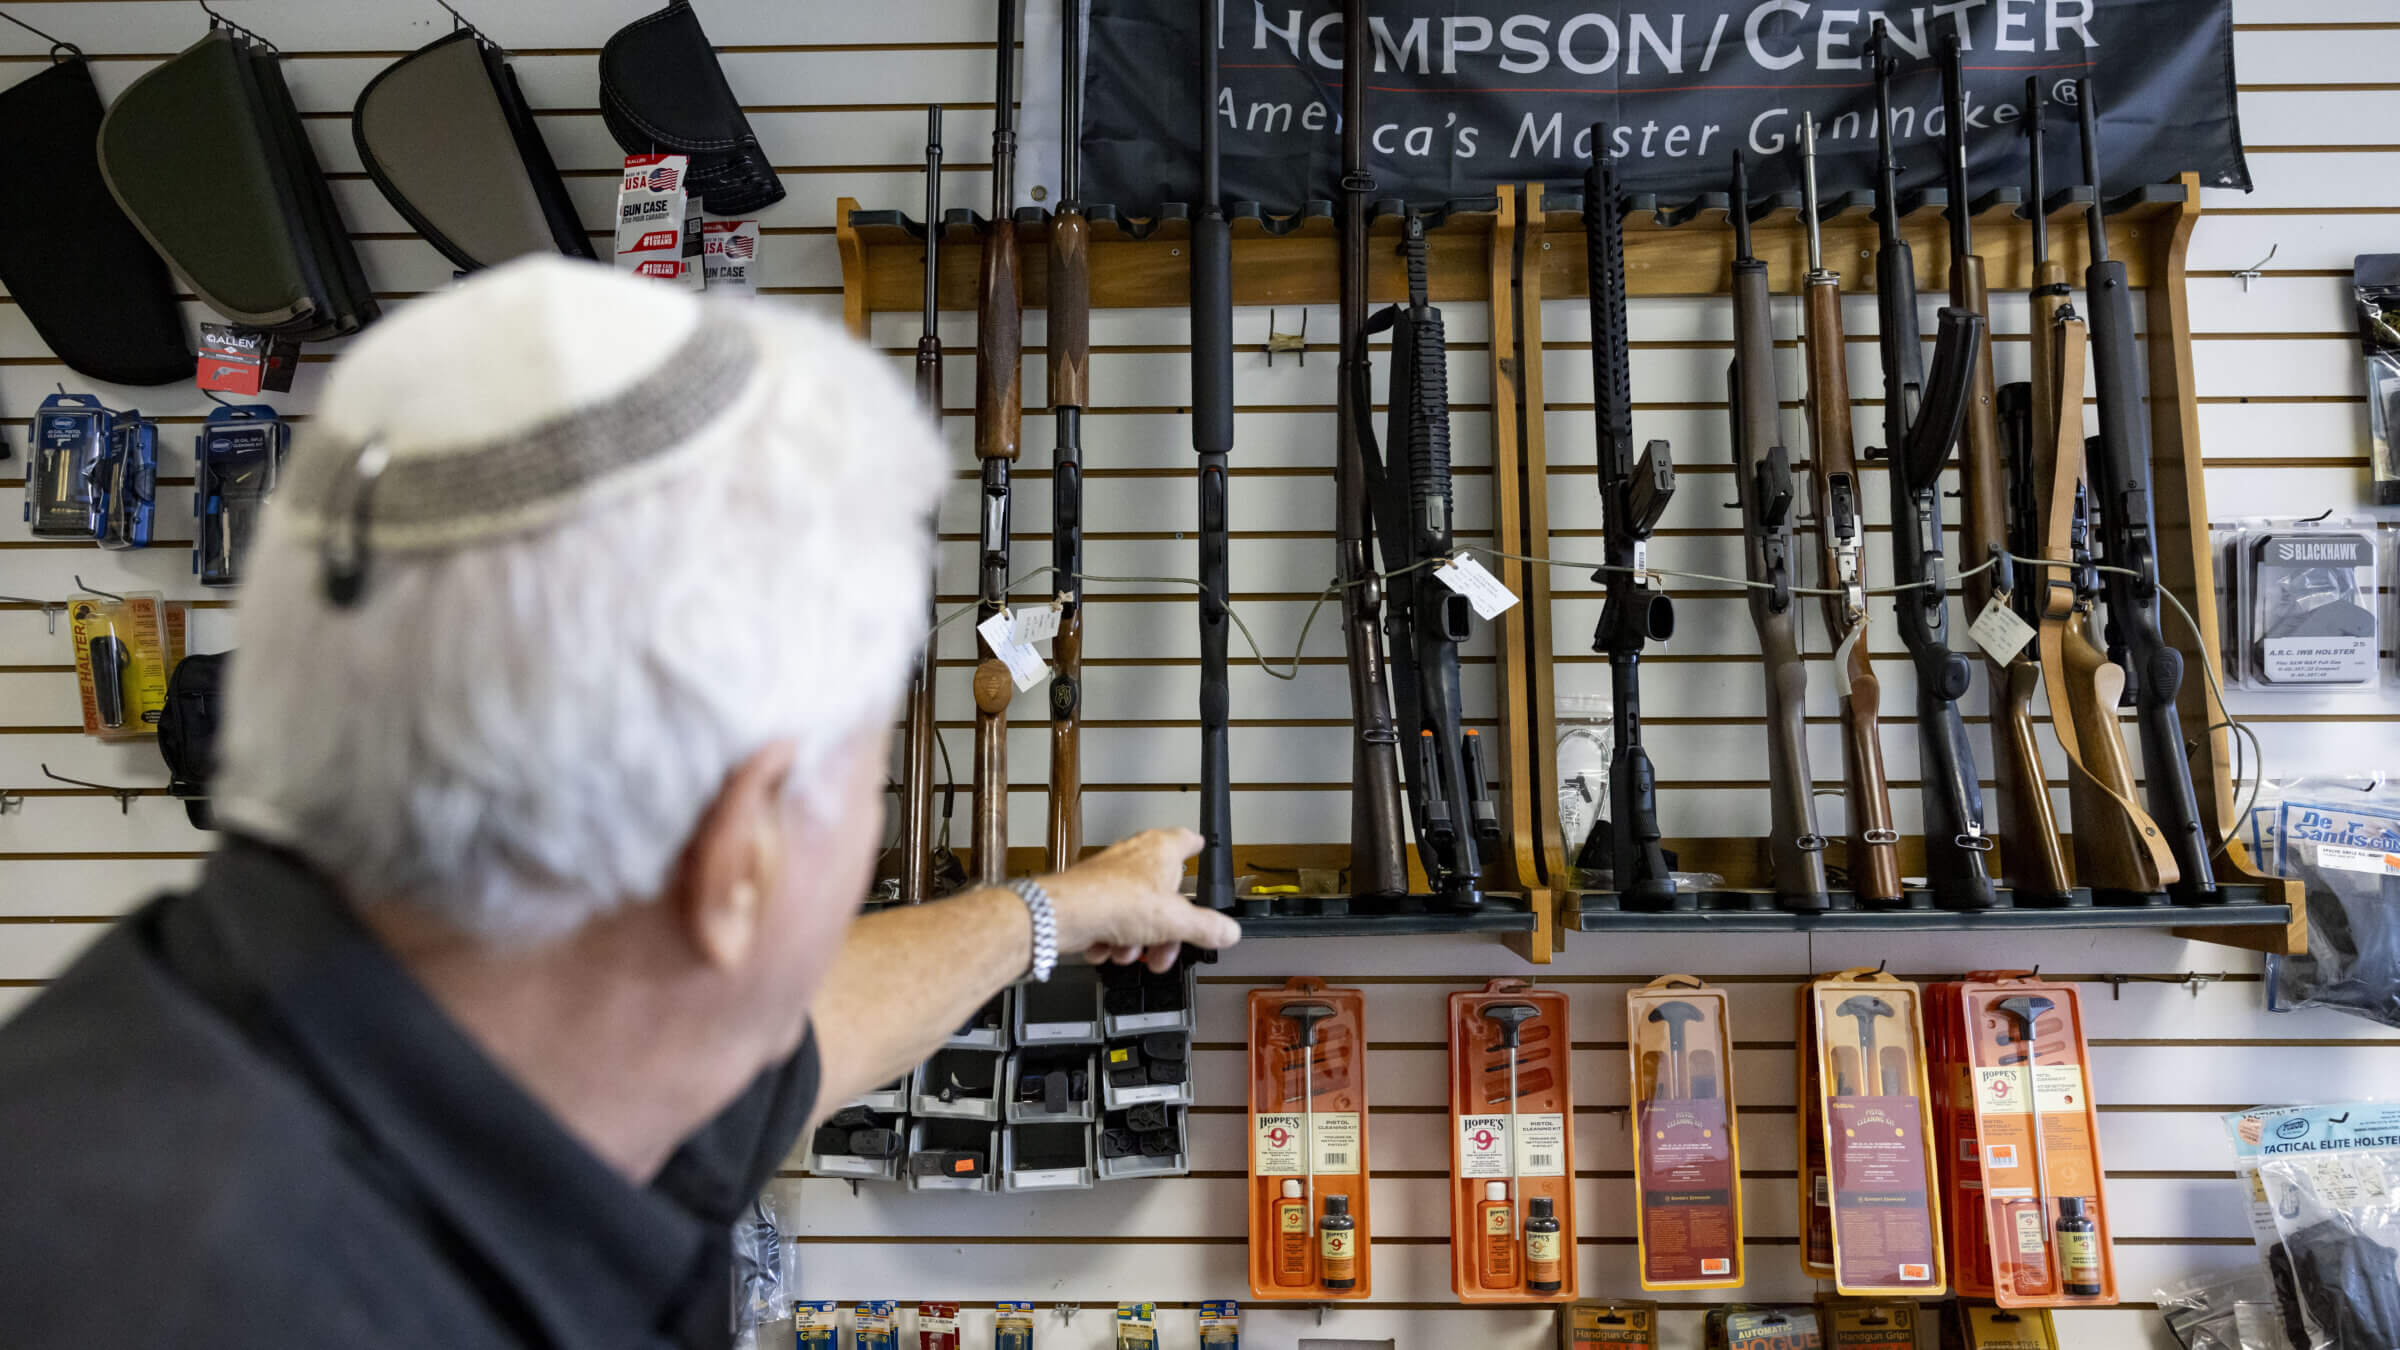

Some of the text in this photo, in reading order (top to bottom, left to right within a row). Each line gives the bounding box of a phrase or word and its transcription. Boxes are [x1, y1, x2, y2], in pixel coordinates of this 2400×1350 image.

[1218, 86, 1479, 160] Ameca's
[1509, 111, 1721, 159] Master
[625, 175, 647, 191] USA
[623, 203, 642, 217] GUN
[643, 199, 668, 214] CASE
[642, 235, 653, 248] #1
[705, 266, 745, 279] UN CASE
[215, 335, 255, 350] ALLEN
[2294, 543, 2358, 562] BLACKHAWK
[74, 624, 92, 683] HALTER
[2314, 648, 2356, 656] HOLSTER
[81, 685, 98, 732] CRIME
[2302, 811, 2333, 830] De
[2288, 822, 2369, 848] Santis
[1983, 1070, 2017, 1083] HOPPE'S
[1990, 1080, 2010, 1099] 9
[1259, 1116, 1300, 1130] HOPPE'S
[1464, 1118, 1504, 1133] HOPPE'S
[1268, 1127, 1290, 1149] 9
[1473, 1129, 1494, 1151] 9
[2264, 1141, 2317, 1155] TACTICAL
[2320, 1138, 2351, 1150] ELITE
[1288, 1213, 1299, 1225] 9
[1330, 1238, 1344, 1251] 9
[1575, 1329, 1647, 1343] Handgun Grips
[1737, 1322, 1793, 1340] AUTOMATIC
[1839, 1331, 1912, 1343] Handgun Grips
